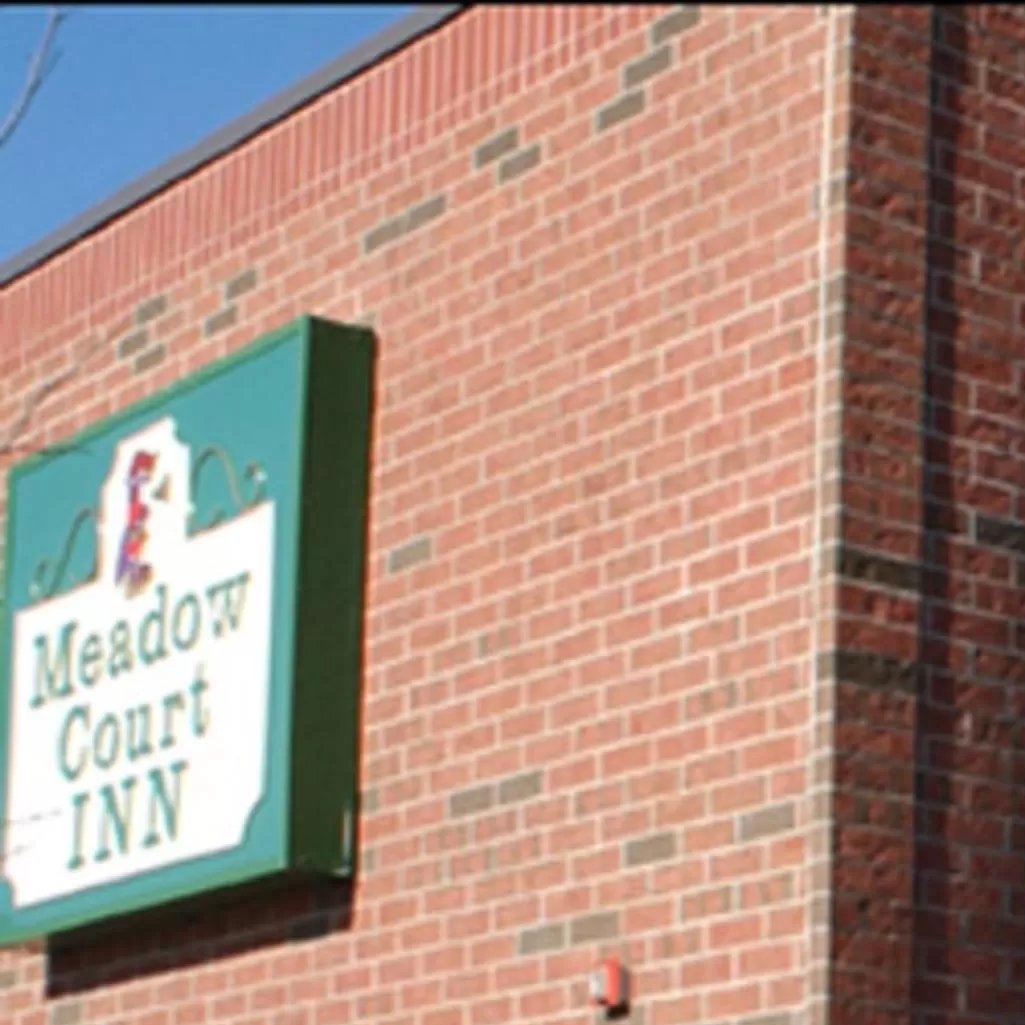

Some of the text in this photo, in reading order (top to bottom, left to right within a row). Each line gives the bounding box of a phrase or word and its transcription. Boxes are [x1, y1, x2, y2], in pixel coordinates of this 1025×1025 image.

[30, 572, 250, 708] Meadow
[58, 664, 210, 781] Court
[67, 762, 187, 869] INN
